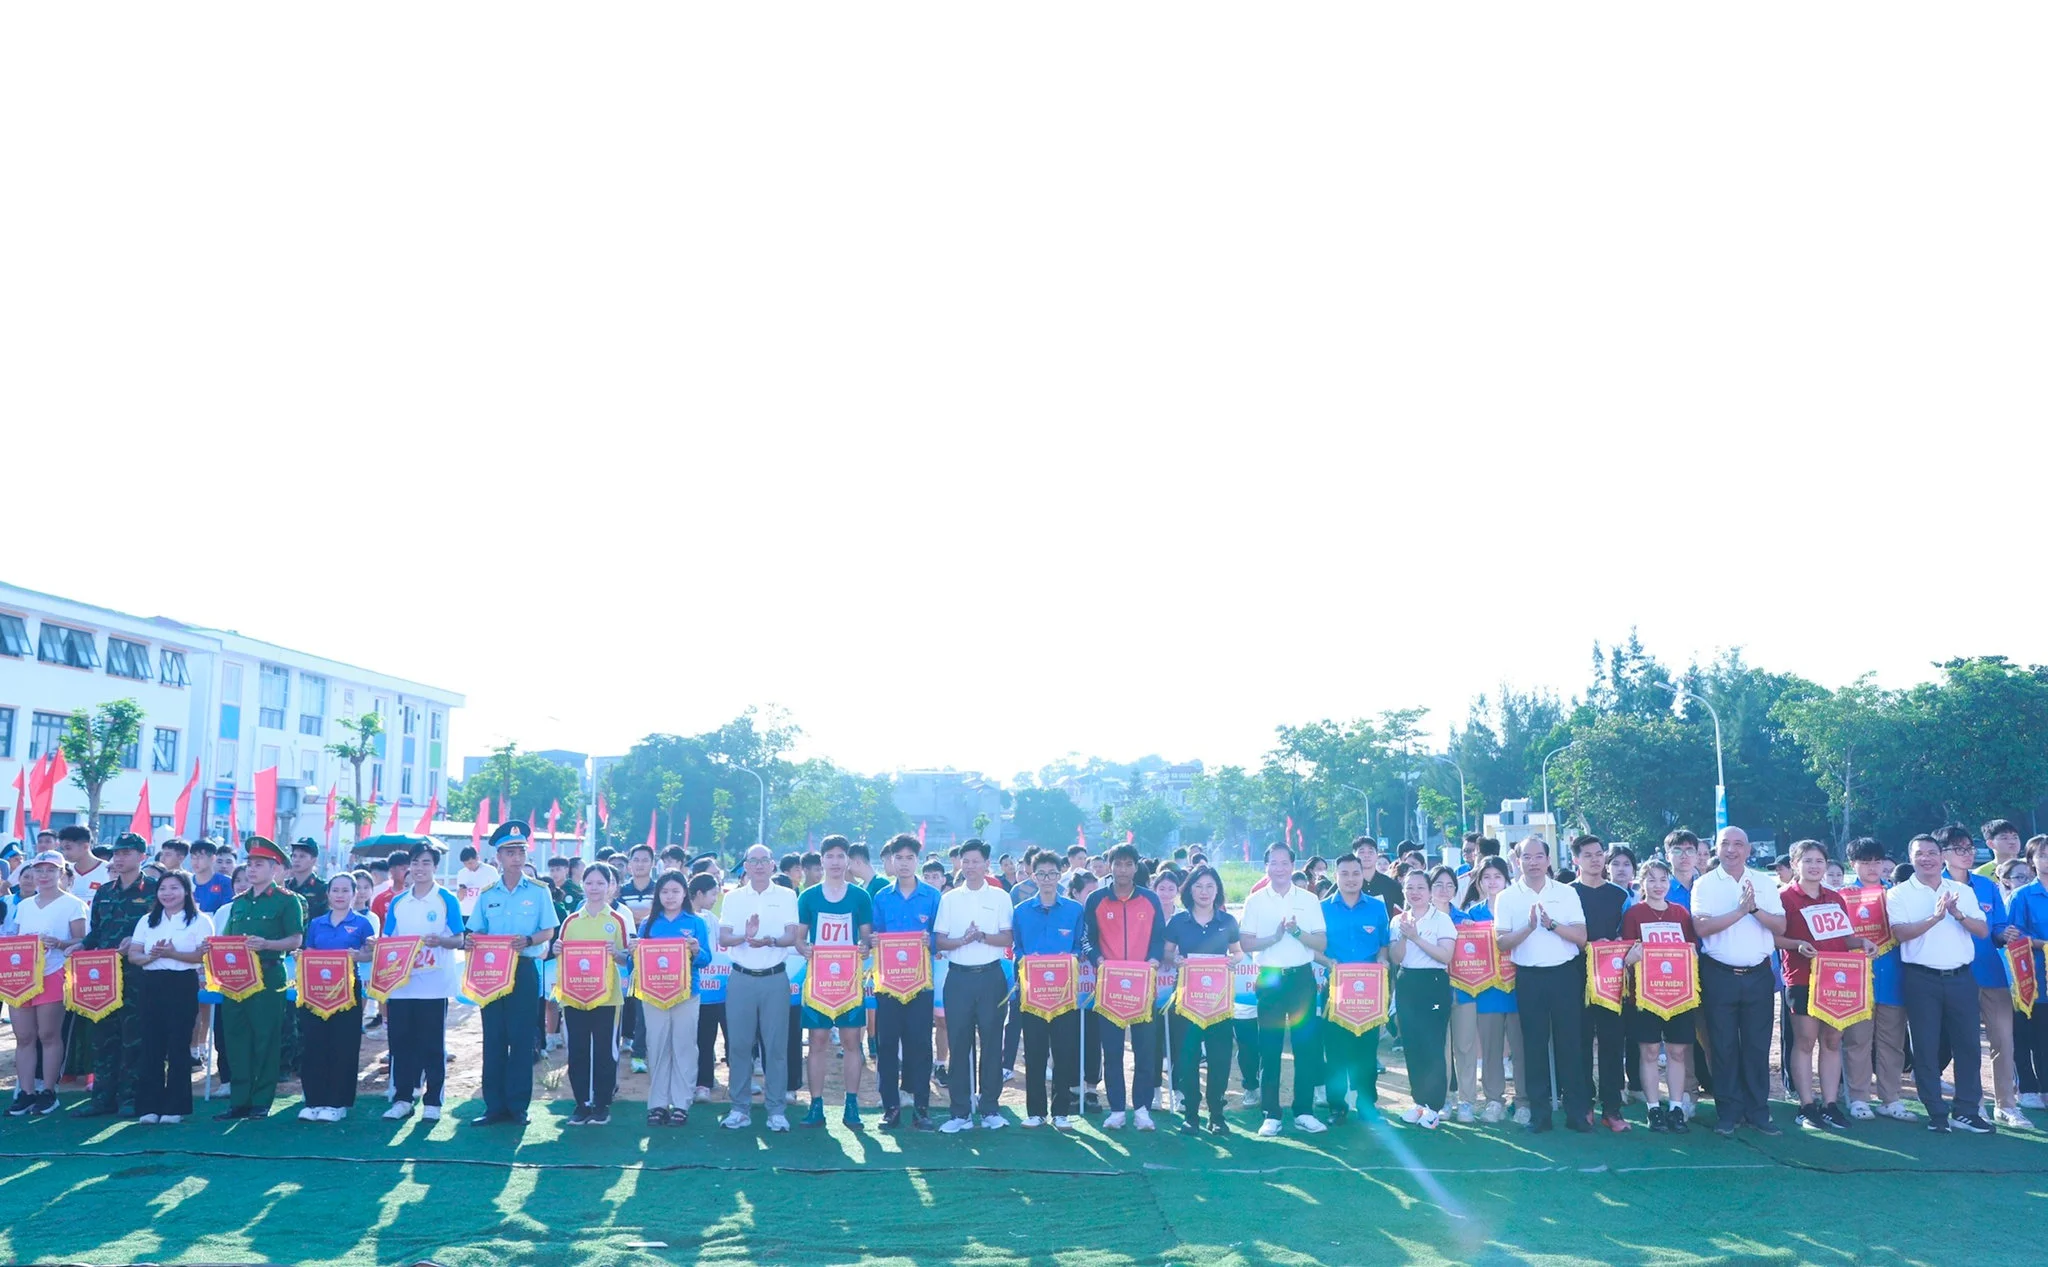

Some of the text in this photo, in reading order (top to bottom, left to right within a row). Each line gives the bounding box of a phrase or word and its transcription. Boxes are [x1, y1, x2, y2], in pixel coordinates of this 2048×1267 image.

[821, 922, 849, 941] 071
[1811, 911, 1848, 933] 052
[413, 949, 436, 968] 24
